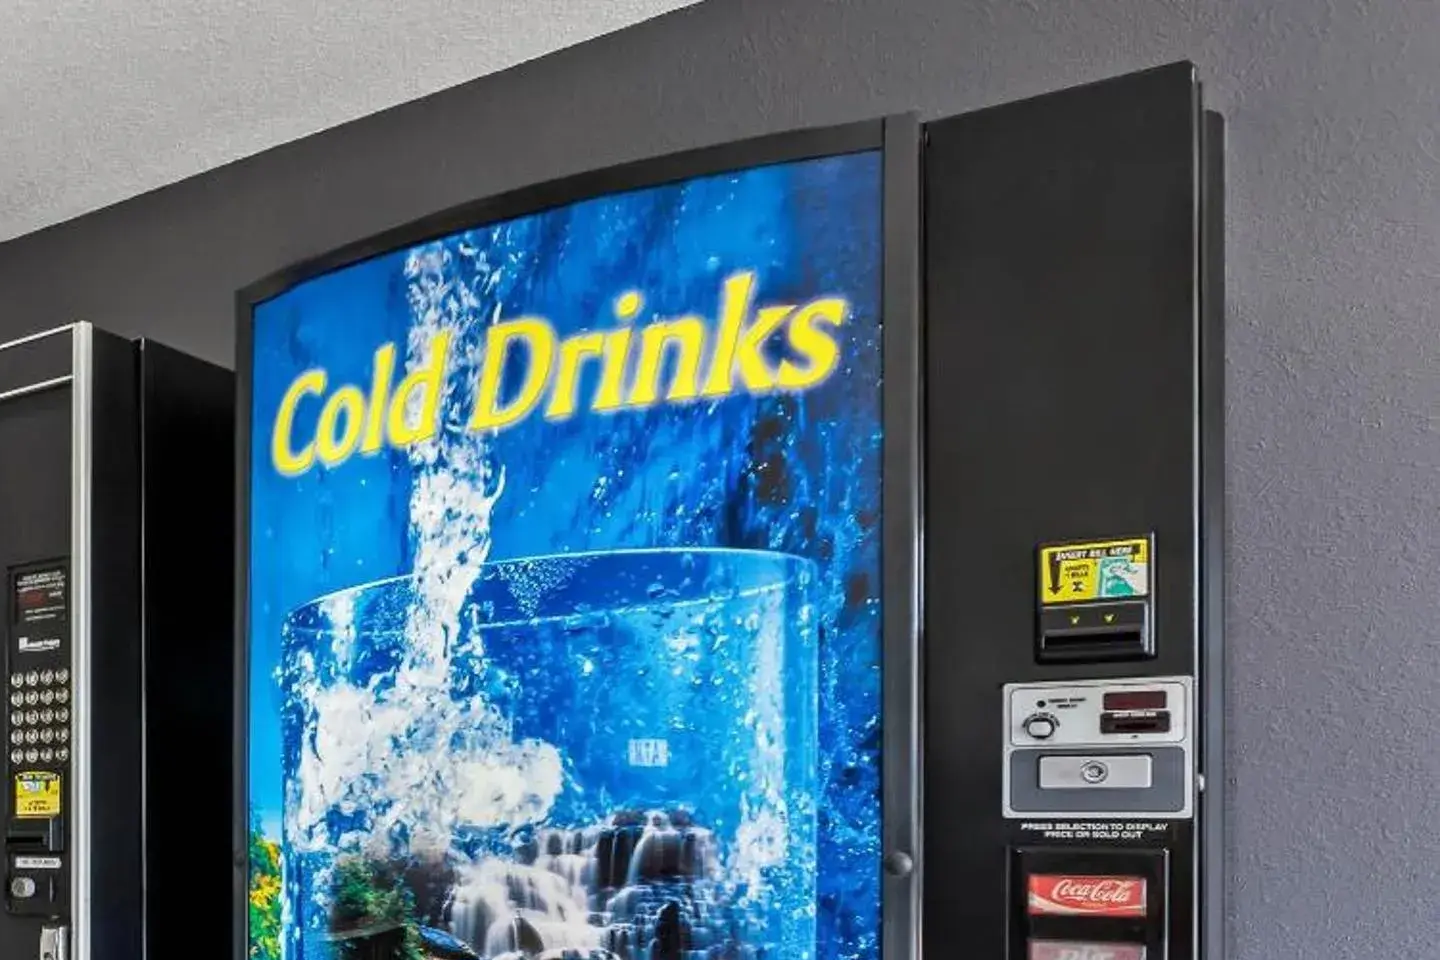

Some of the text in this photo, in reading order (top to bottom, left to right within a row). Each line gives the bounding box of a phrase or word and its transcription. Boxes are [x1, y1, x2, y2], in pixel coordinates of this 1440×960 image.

[271, 271, 847, 475] Cold Drinks
[1125, 823, 1168, 831] DISPLAY
